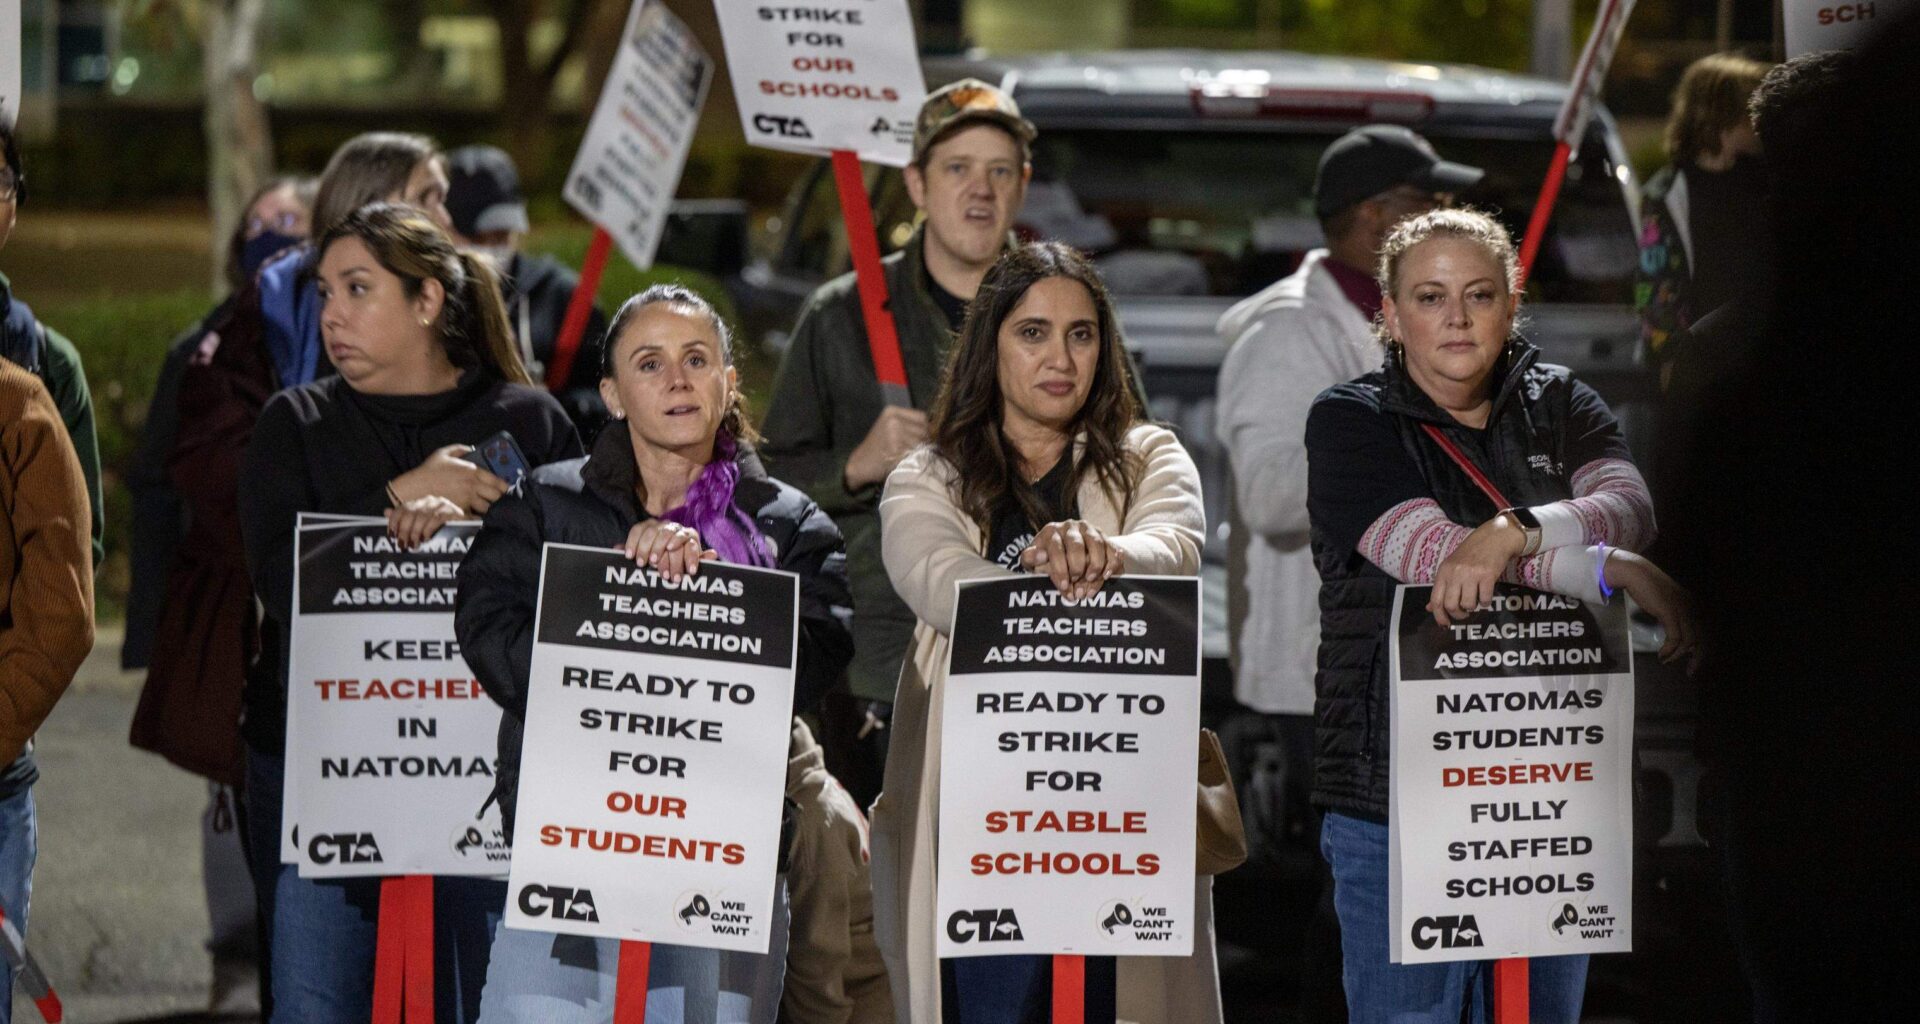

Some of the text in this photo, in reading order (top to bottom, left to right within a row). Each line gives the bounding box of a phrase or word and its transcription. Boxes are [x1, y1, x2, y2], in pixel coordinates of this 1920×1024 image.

[757, 6, 863, 25] STRIKE
[786, 32, 844, 47] FOR
[792, 57, 854, 73] OUR
[758, 80, 899, 102] SCHOOLS
[753, 112, 813, 139] CTA
[599, 593, 746, 625] TEACHERS
[576, 620, 762, 655] ASSOCIATION
[1004, 618, 1147, 636] TEACHERS
[1450, 621, 1585, 641] TEACHERS
[984, 645, 1164, 664] ASSOCIATION
[1434, 648, 1602, 669] ASSOCIATION
[562, 665, 754, 704] READY TO
[977, 692, 1165, 715] READY TO
[1436, 689, 1603, 714] NATOMAS
[398, 718, 437, 738] IN
[580, 709, 722, 742] STRIKE
[999, 732, 1138, 753] STRIKE
[1433, 725, 1604, 750] STUDENTS
[321, 757, 498, 778] NATOMA
[609, 751, 686, 778] FOR
[1443, 762, 1593, 787] DESERVE
[1026, 771, 1101, 791] FOR
[607, 792, 686, 818] OUR
[1471, 800, 1567, 823] FULLY
[986, 811, 1146, 833] STABLE
[308, 832, 384, 865] CTA
[540, 825, 745, 865] STUDENTS
[1448, 836, 1592, 861] STAFFED
[971, 853, 1159, 875] SCHOOLS
[1446, 873, 1594, 898] SCHOOLS
[518, 884, 599, 923] CTA
[722, 901, 745, 911] WE
[1143, 908, 1166, 916] WE
[1587, 905, 1608, 914] WE
[712, 925, 749, 935] WAIT
[947, 909, 1024, 943] CTA
[1135, 932, 1172, 940] WAIT
[1411, 915, 1483, 950] CTA
[1581, 929, 1613, 938] WAIT
